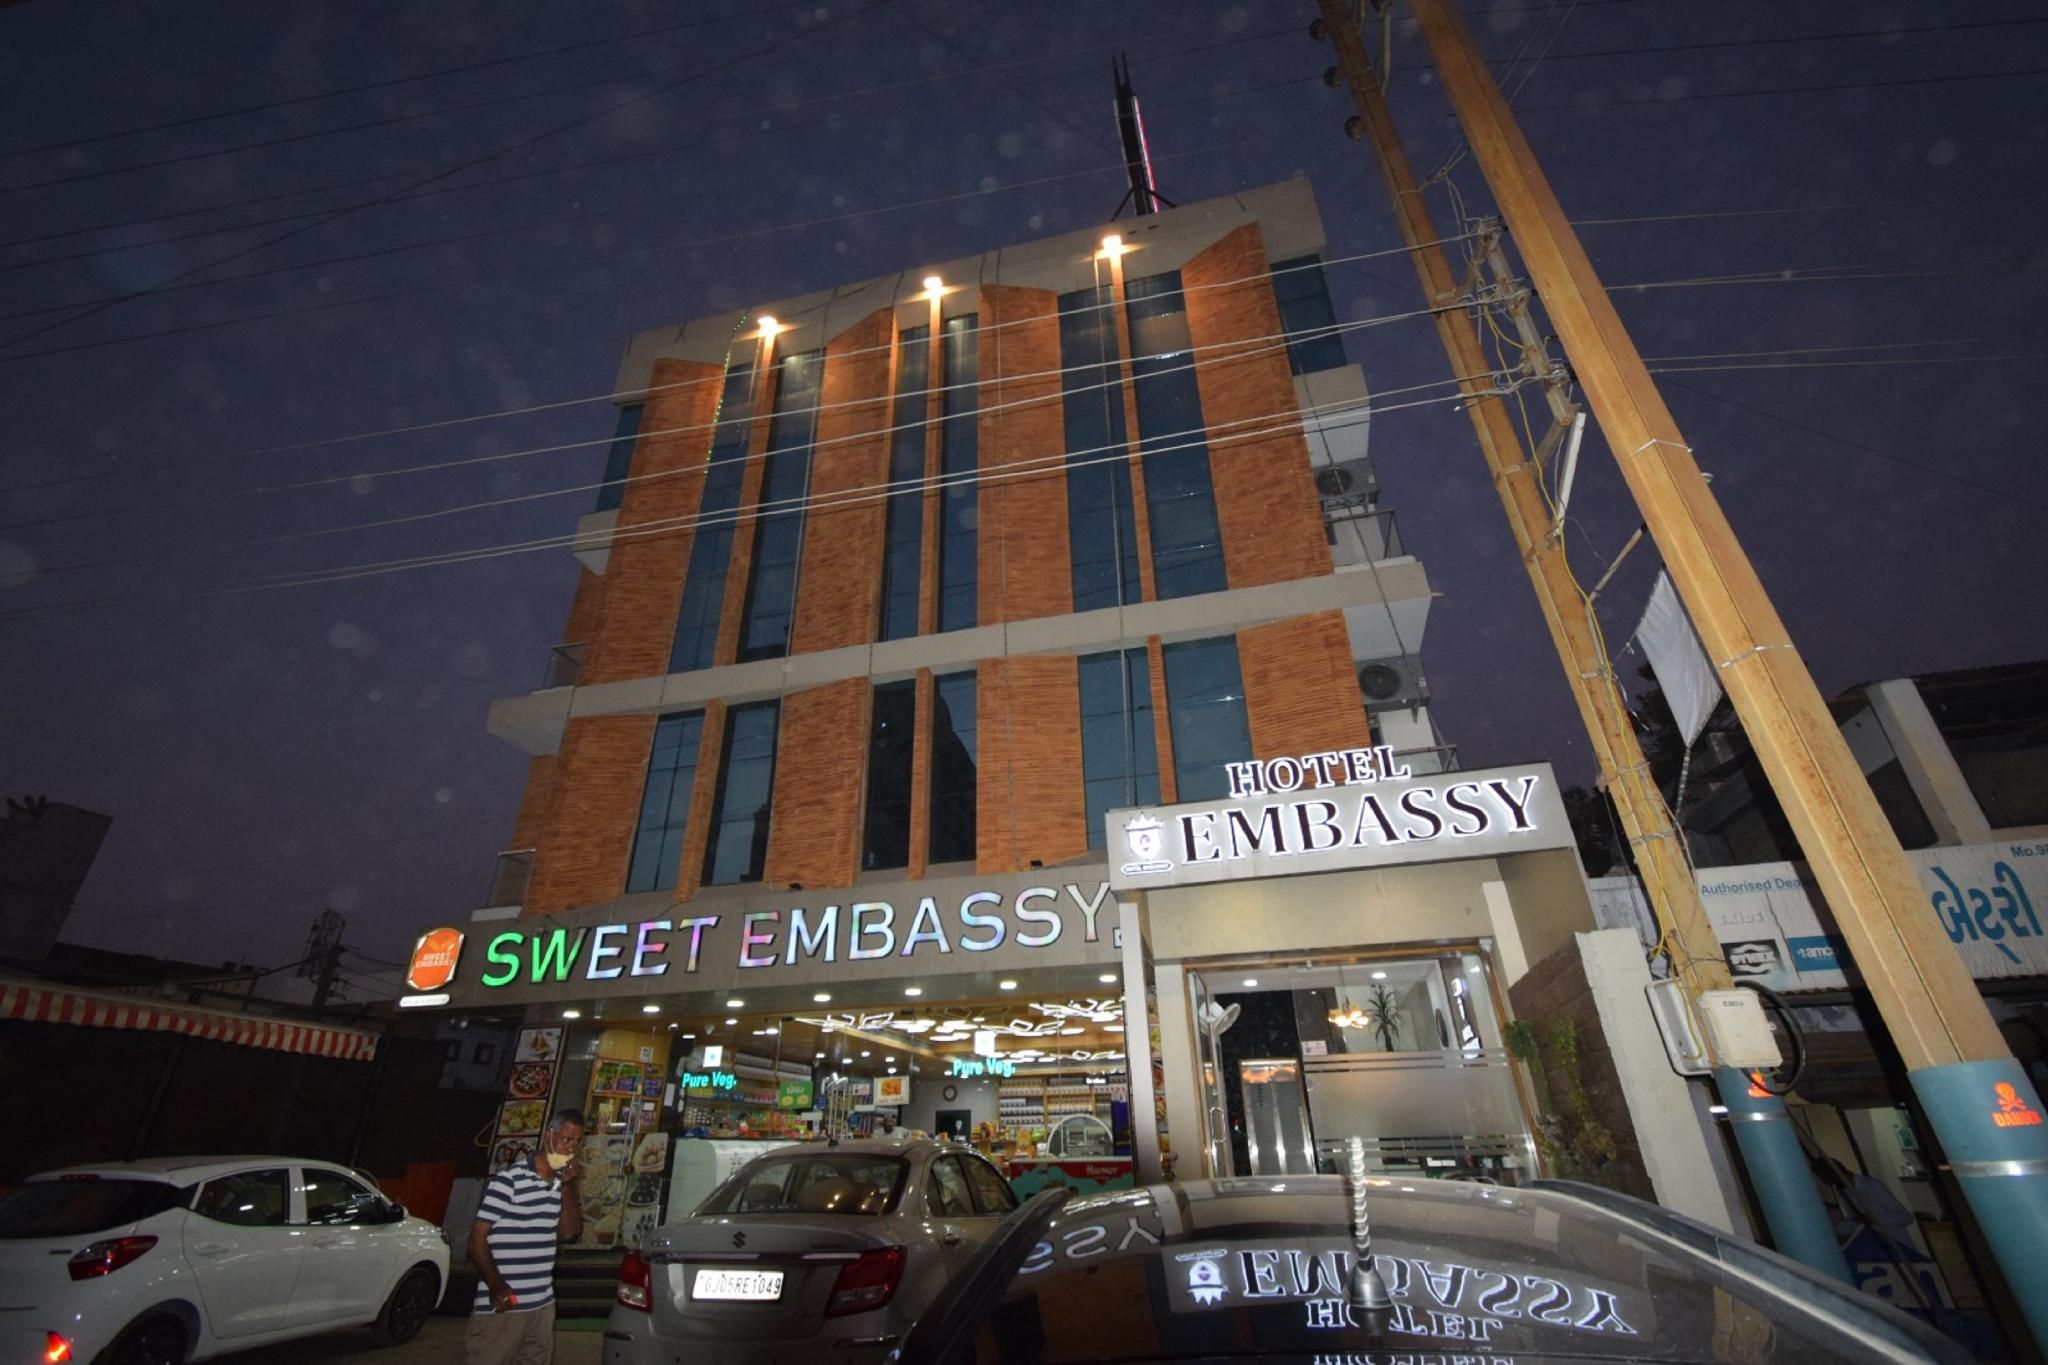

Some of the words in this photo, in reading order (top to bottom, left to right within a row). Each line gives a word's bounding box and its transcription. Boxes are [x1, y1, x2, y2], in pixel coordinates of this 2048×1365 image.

[1226, 745, 1411, 798] HOTEL
[1177, 775, 1539, 866] EMBASSY
[1701, 879, 1771, 896] Authorised
[481, 915, 720, 988] SWEET
[738, 880, 1111, 969] EMBASSY
[682, 1072, 709, 1088] Pure
[711, 1070, 737, 1090] Veg.
